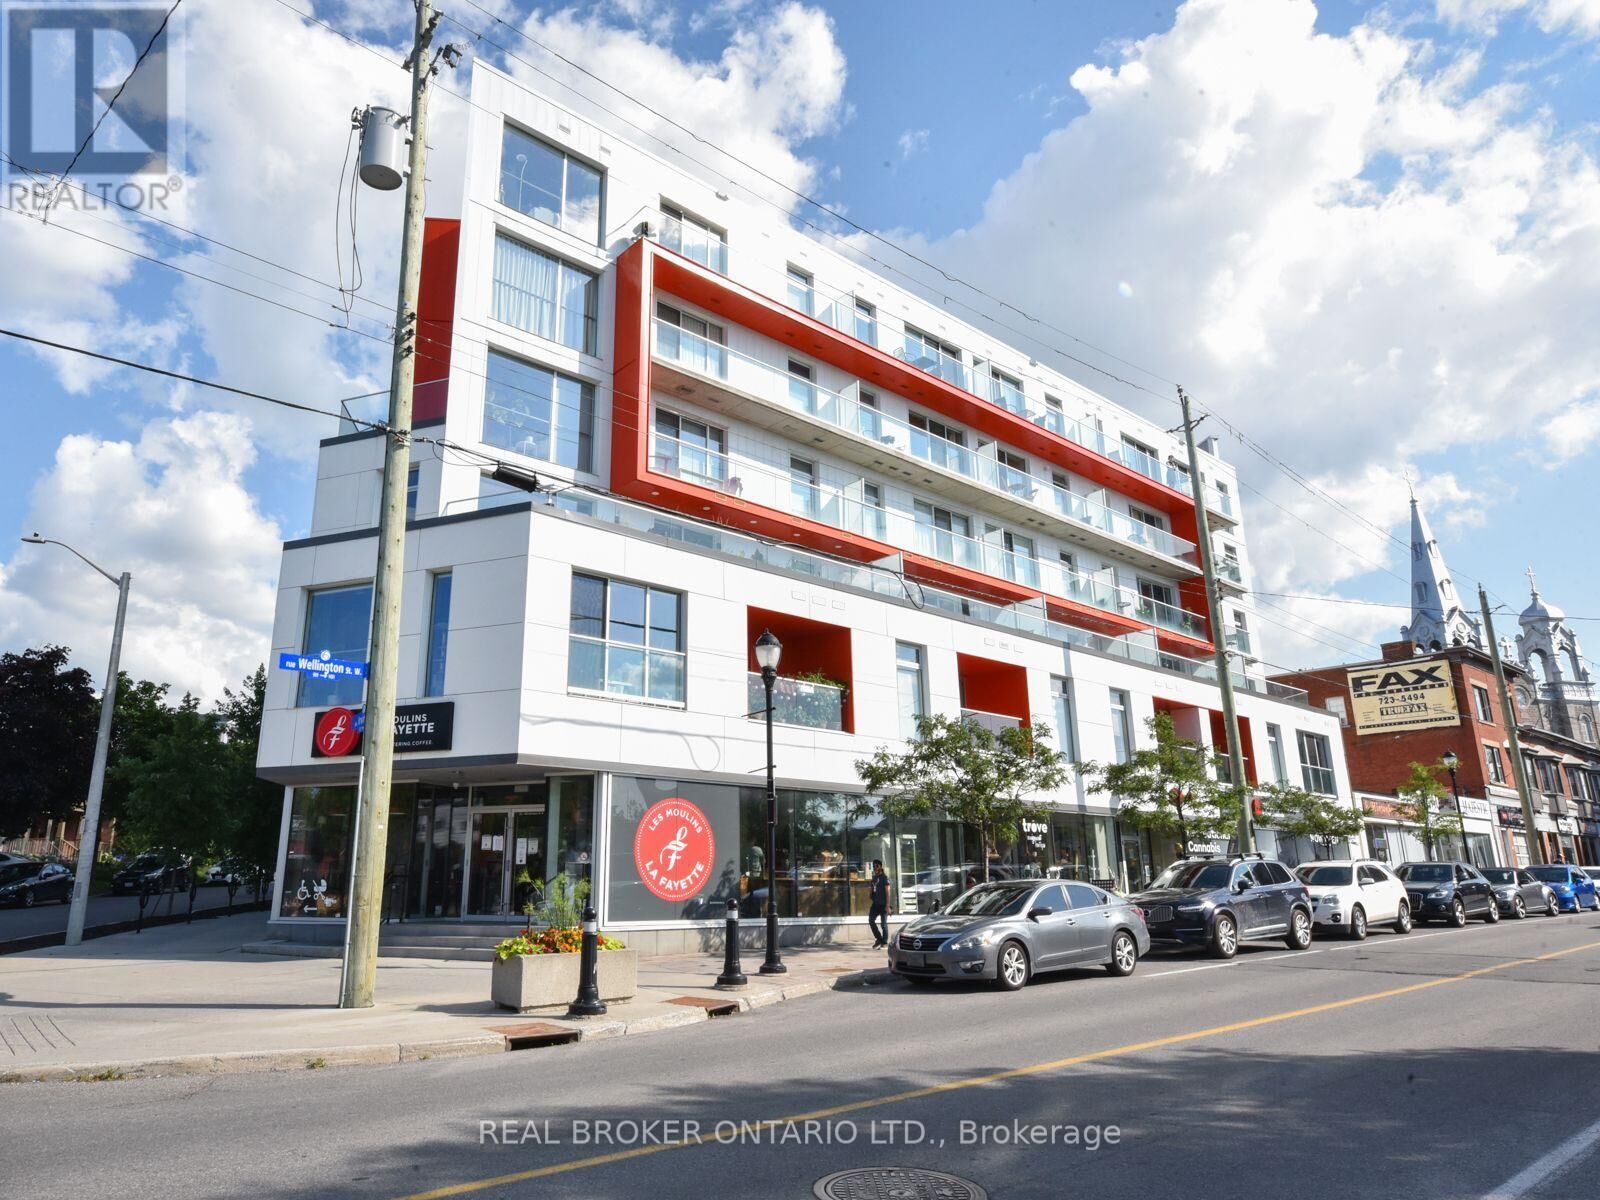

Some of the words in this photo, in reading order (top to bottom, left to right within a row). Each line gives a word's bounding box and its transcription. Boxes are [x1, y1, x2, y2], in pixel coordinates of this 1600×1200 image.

[298, 658, 344, 675] Wellington
[345, 666, 353, 674] St.
[354, 667, 362, 676] W.
[1351, 665, 1446, 692] FAX
[1378, 692, 1425, 705] 723-5494
[1381, 703, 1426, 715] TRUEFAX
[394, 713, 427, 724] OULINS
[393, 722, 435, 735] AYETTE
[648, 813, 663, 831] LES
[665, 808, 703, 834] MOULINS
[1022, 818, 1048, 833] trove
[1187, 840, 1221, 853] Cannabis
[645, 860, 659, 880] LA
[659, 861, 704, 890] FAYETTE
